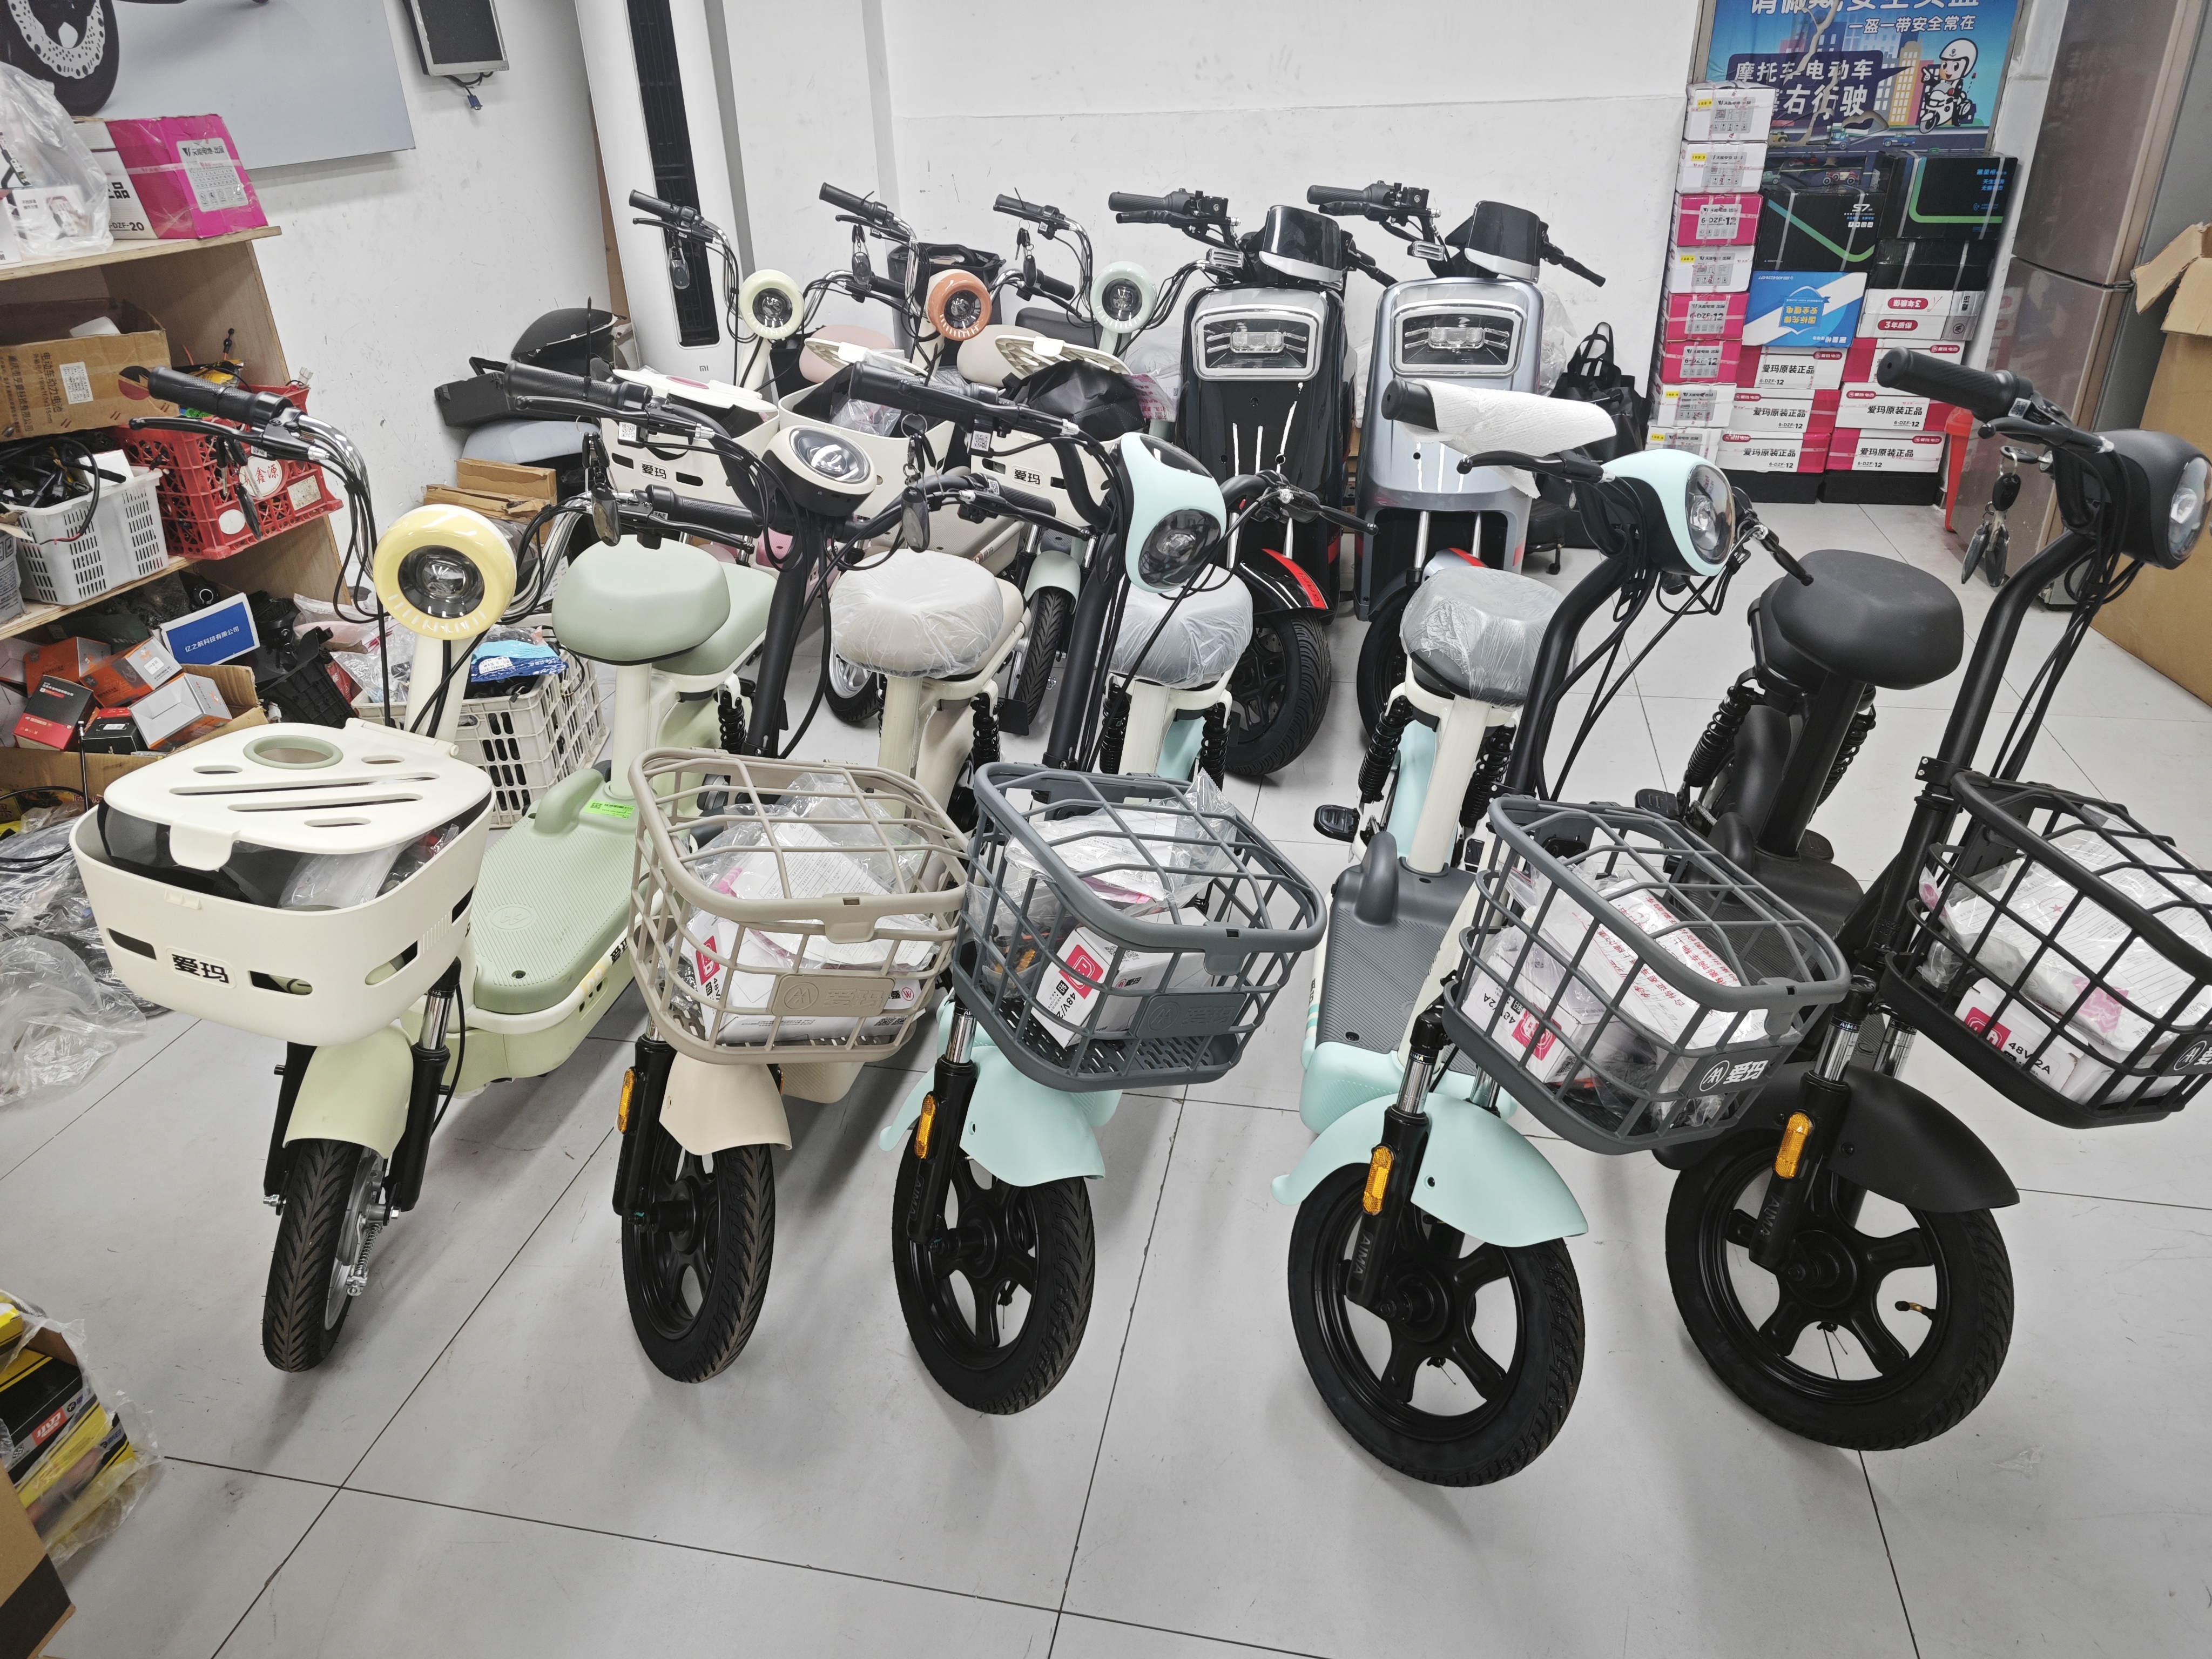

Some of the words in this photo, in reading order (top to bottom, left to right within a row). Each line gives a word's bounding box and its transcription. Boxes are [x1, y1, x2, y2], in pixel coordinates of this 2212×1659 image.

[1849, 15, 1976, 33] 一盔一带安全常在
[1735, 59, 1874, 82] 摩托车电动车
[1772, 84, 1867, 120] 右行驶
[109, 182, 130, 199] 品
[1852, 204, 1870, 212] S7
[1701, 217, 1736, 225] 6-DZF-12
[1762, 365, 1815, 374] 爱玛原装正品
[42, 352, 63, 413] 电动车动力电池
[1753, 407, 1805, 417] 爱玛原装正品
[1867, 406, 1922, 415] 爱玛原装正品
[1743, 448, 1796, 457] 爱玛原装正品
[1860, 448, 1913, 457] 爱玛原装正品
[642, 463, 666, 479] 爱玛
[1014, 469, 1040, 484] 爱玛
[185, 626, 240, 652] 亿之航科技有限公司
[171, 954, 230, 984] 爱玛
[1057, 981, 1069, 995] 铅
[823, 989, 884, 1008] 爱玛
[1183, 1006, 1236, 1025] 爱玛
[1839, 1021, 1857, 1031] AIMA
[2008, 1042, 2051, 1075] 48V2A
[1723, 1060, 1769, 1084] 爱玛
[1760, 1195, 1781, 1238] AIMA
[1353, 1233, 1371, 1274] AIMA
